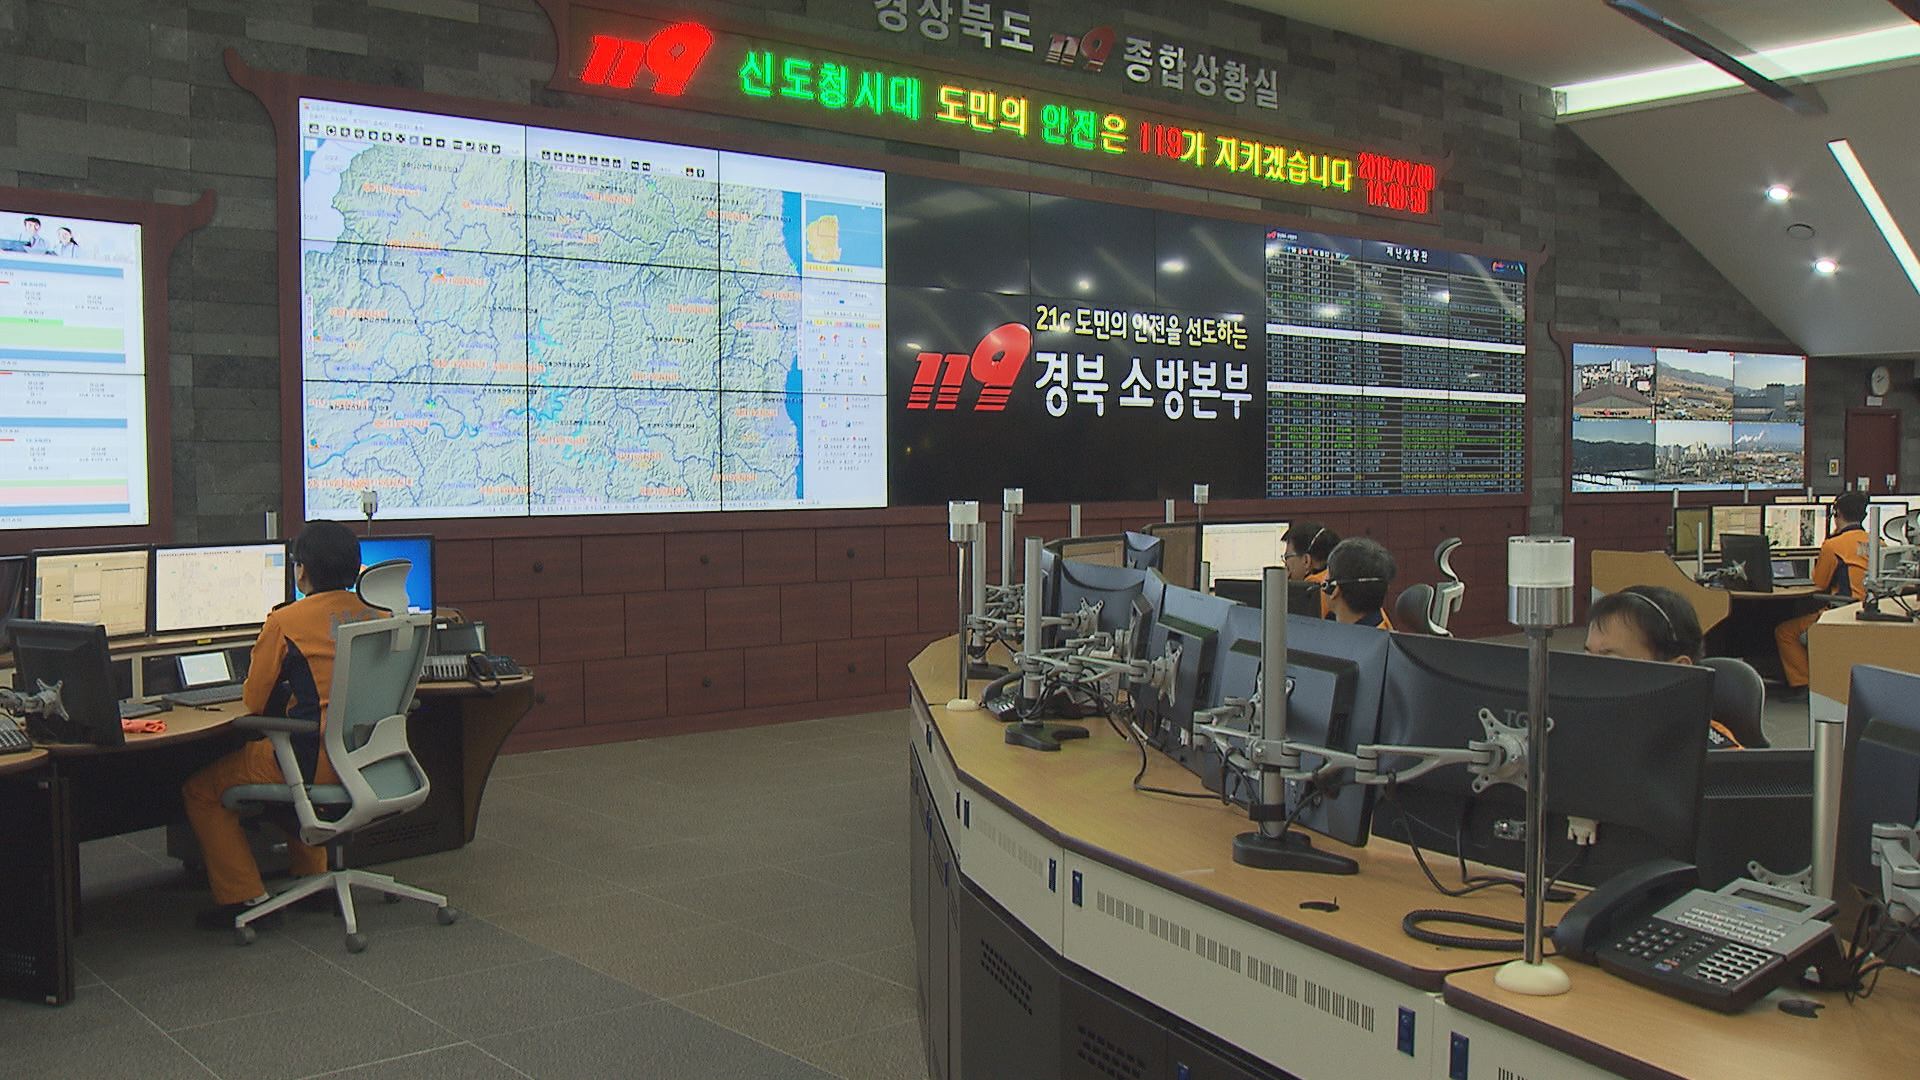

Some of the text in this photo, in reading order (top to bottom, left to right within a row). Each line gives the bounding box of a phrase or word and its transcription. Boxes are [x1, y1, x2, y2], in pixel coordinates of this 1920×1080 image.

[581, 22, 713, 96] 119
[1046, 26, 1117, 73] 119
[1124, 36, 1279, 110] 종합상황실
[738, 51, 1353, 192] 신도청시대 도민의 안전은 119가 지키겠습니다
[906, 321, 1033, 411] 119
[1074, 307, 1128, 341] 도민의
[1131, 312, 1182, 346] 안전을
[1186, 317, 1248, 350] 선도하는
[1035, 351, 1252, 420] 경북 소방본부
